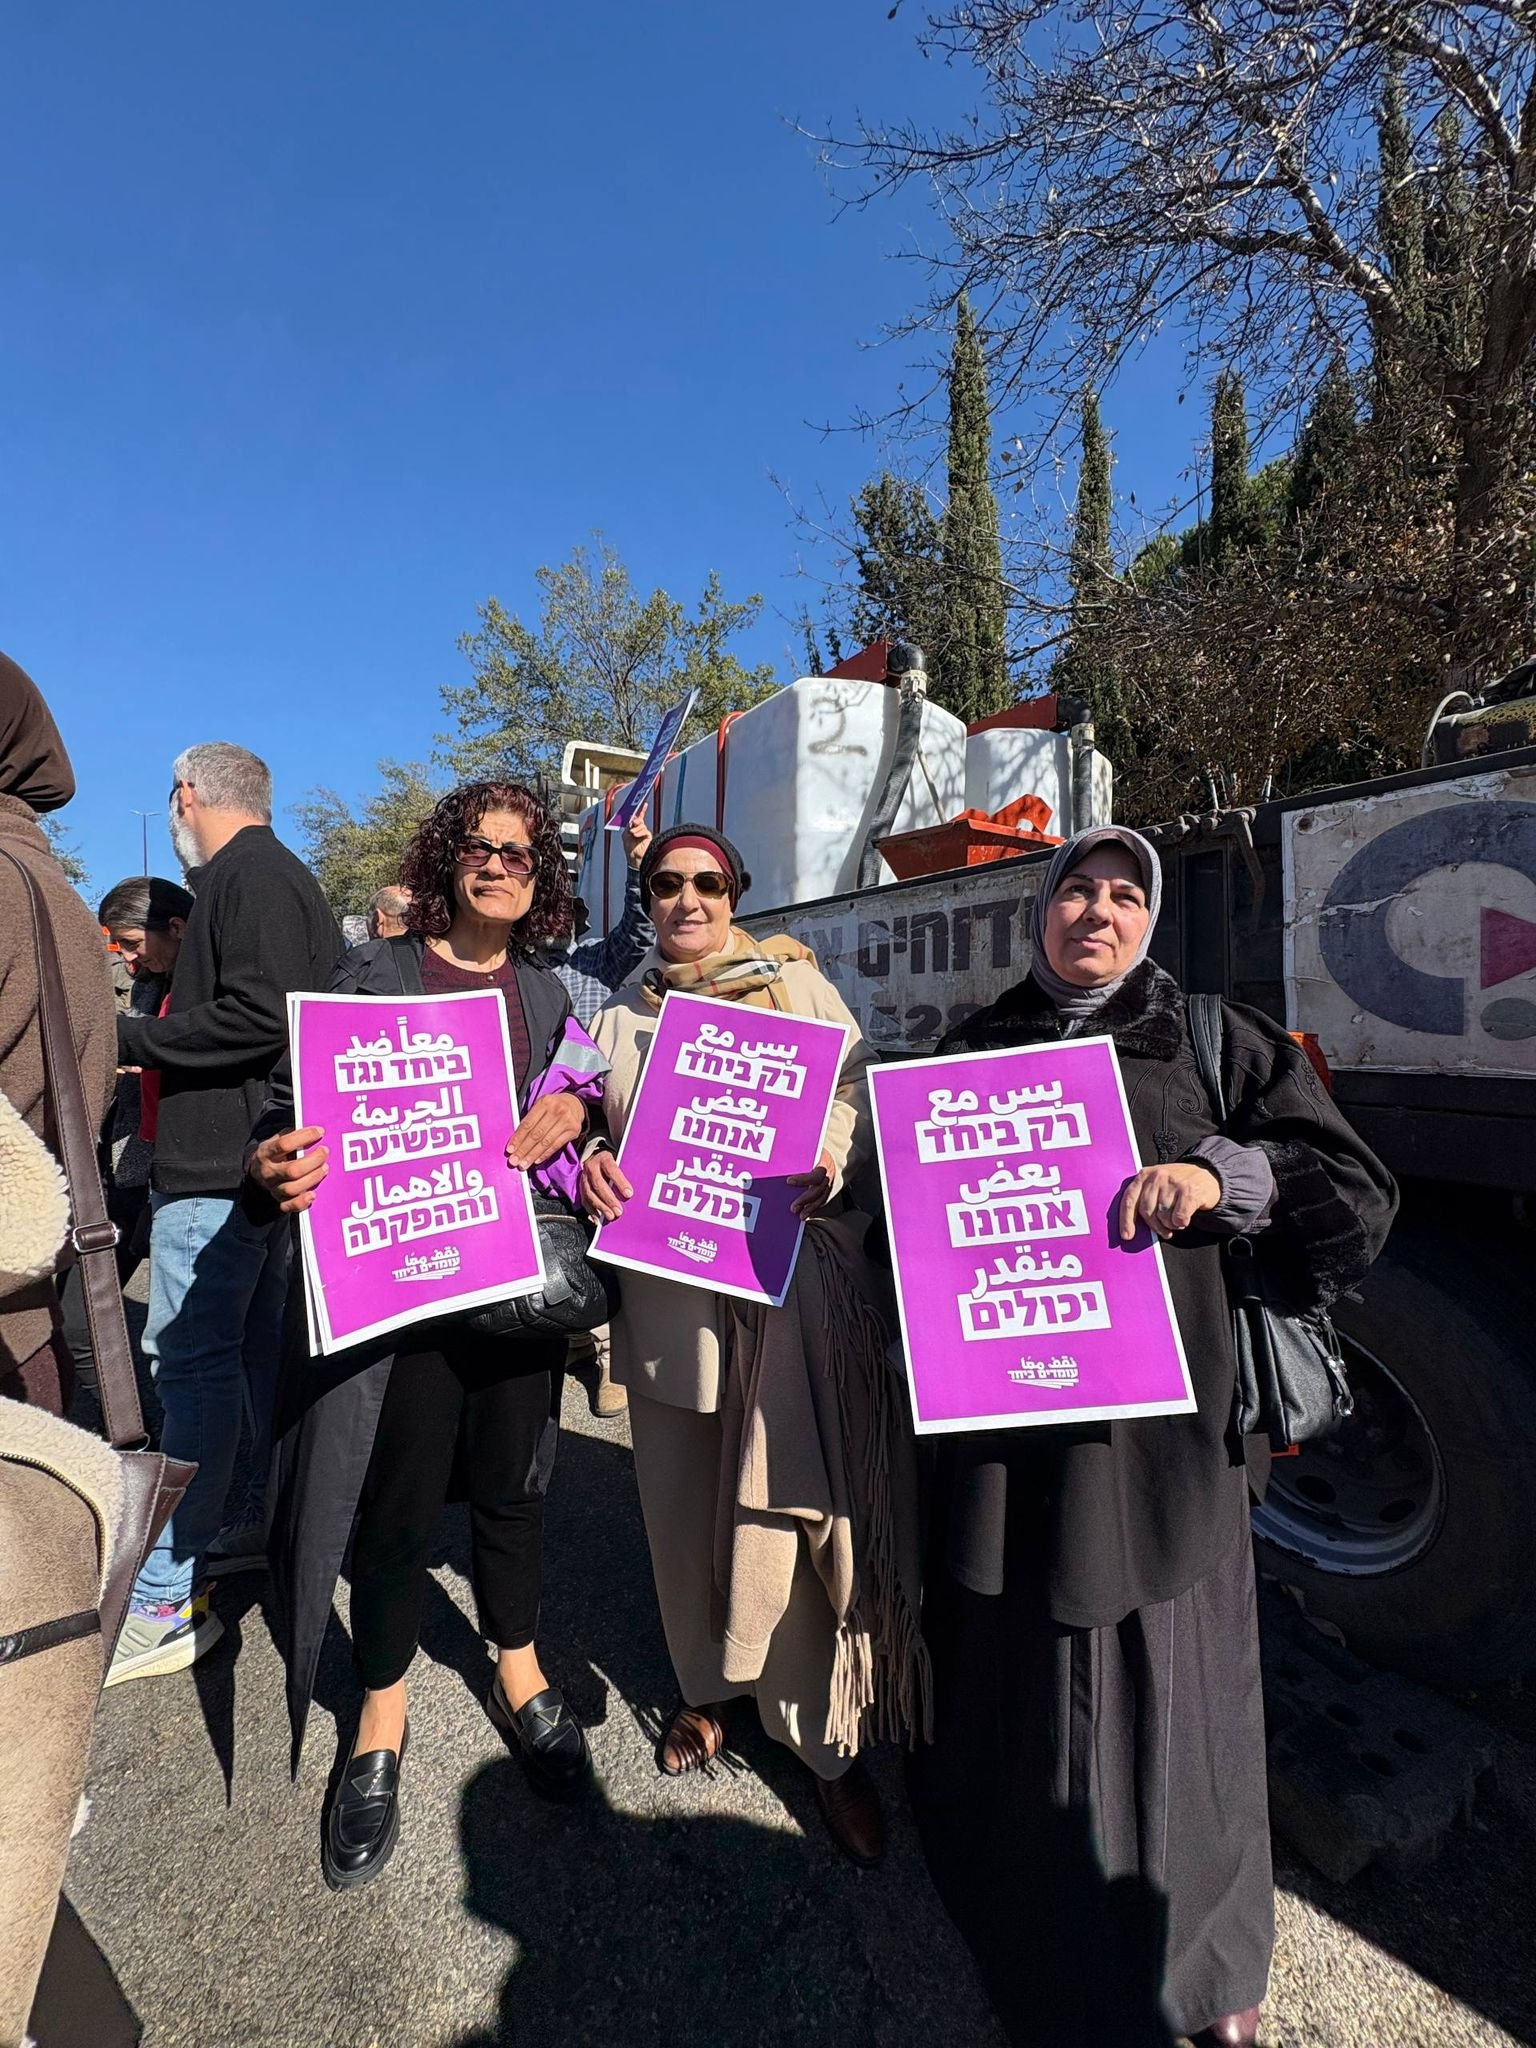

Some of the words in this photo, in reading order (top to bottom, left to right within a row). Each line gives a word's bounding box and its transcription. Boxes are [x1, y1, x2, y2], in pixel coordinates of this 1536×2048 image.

[346, 1030, 393, 1057] ضد
[695, 1024, 734, 1054] مع
[741, 1041, 798, 1066] بس
[339, 1061, 385, 1085] נגד
[390, 1054, 467, 1080] ביחד
[686, 1049, 751, 1082] ביחד
[756, 1066, 798, 1091] רק
[352, 1086, 463, 1131] الجريمة
[691, 1089, 768, 1126] بعض
[929, 1089, 979, 1127] مع
[989, 1080, 1063, 1115] بس
[349, 1124, 474, 1163] הפשיעה
[682, 1116, 764, 1153] אנחנו
[924, 1120, 1020, 1154] ביחד
[1027, 1113, 1081, 1151] רק
[351, 1161, 483, 1219] والاهمال
[667, 1153, 753, 1190] منقدر
[960, 1160, 1061, 1204] بعض
[658, 1182, 752, 1220] יכולים
[959, 1200, 1076, 1237] אנחנו
[348, 1195, 492, 1248] וההפקרה
[971, 1245, 1083, 1299] منقدر
[969, 1290, 1098, 1331] יכולים
